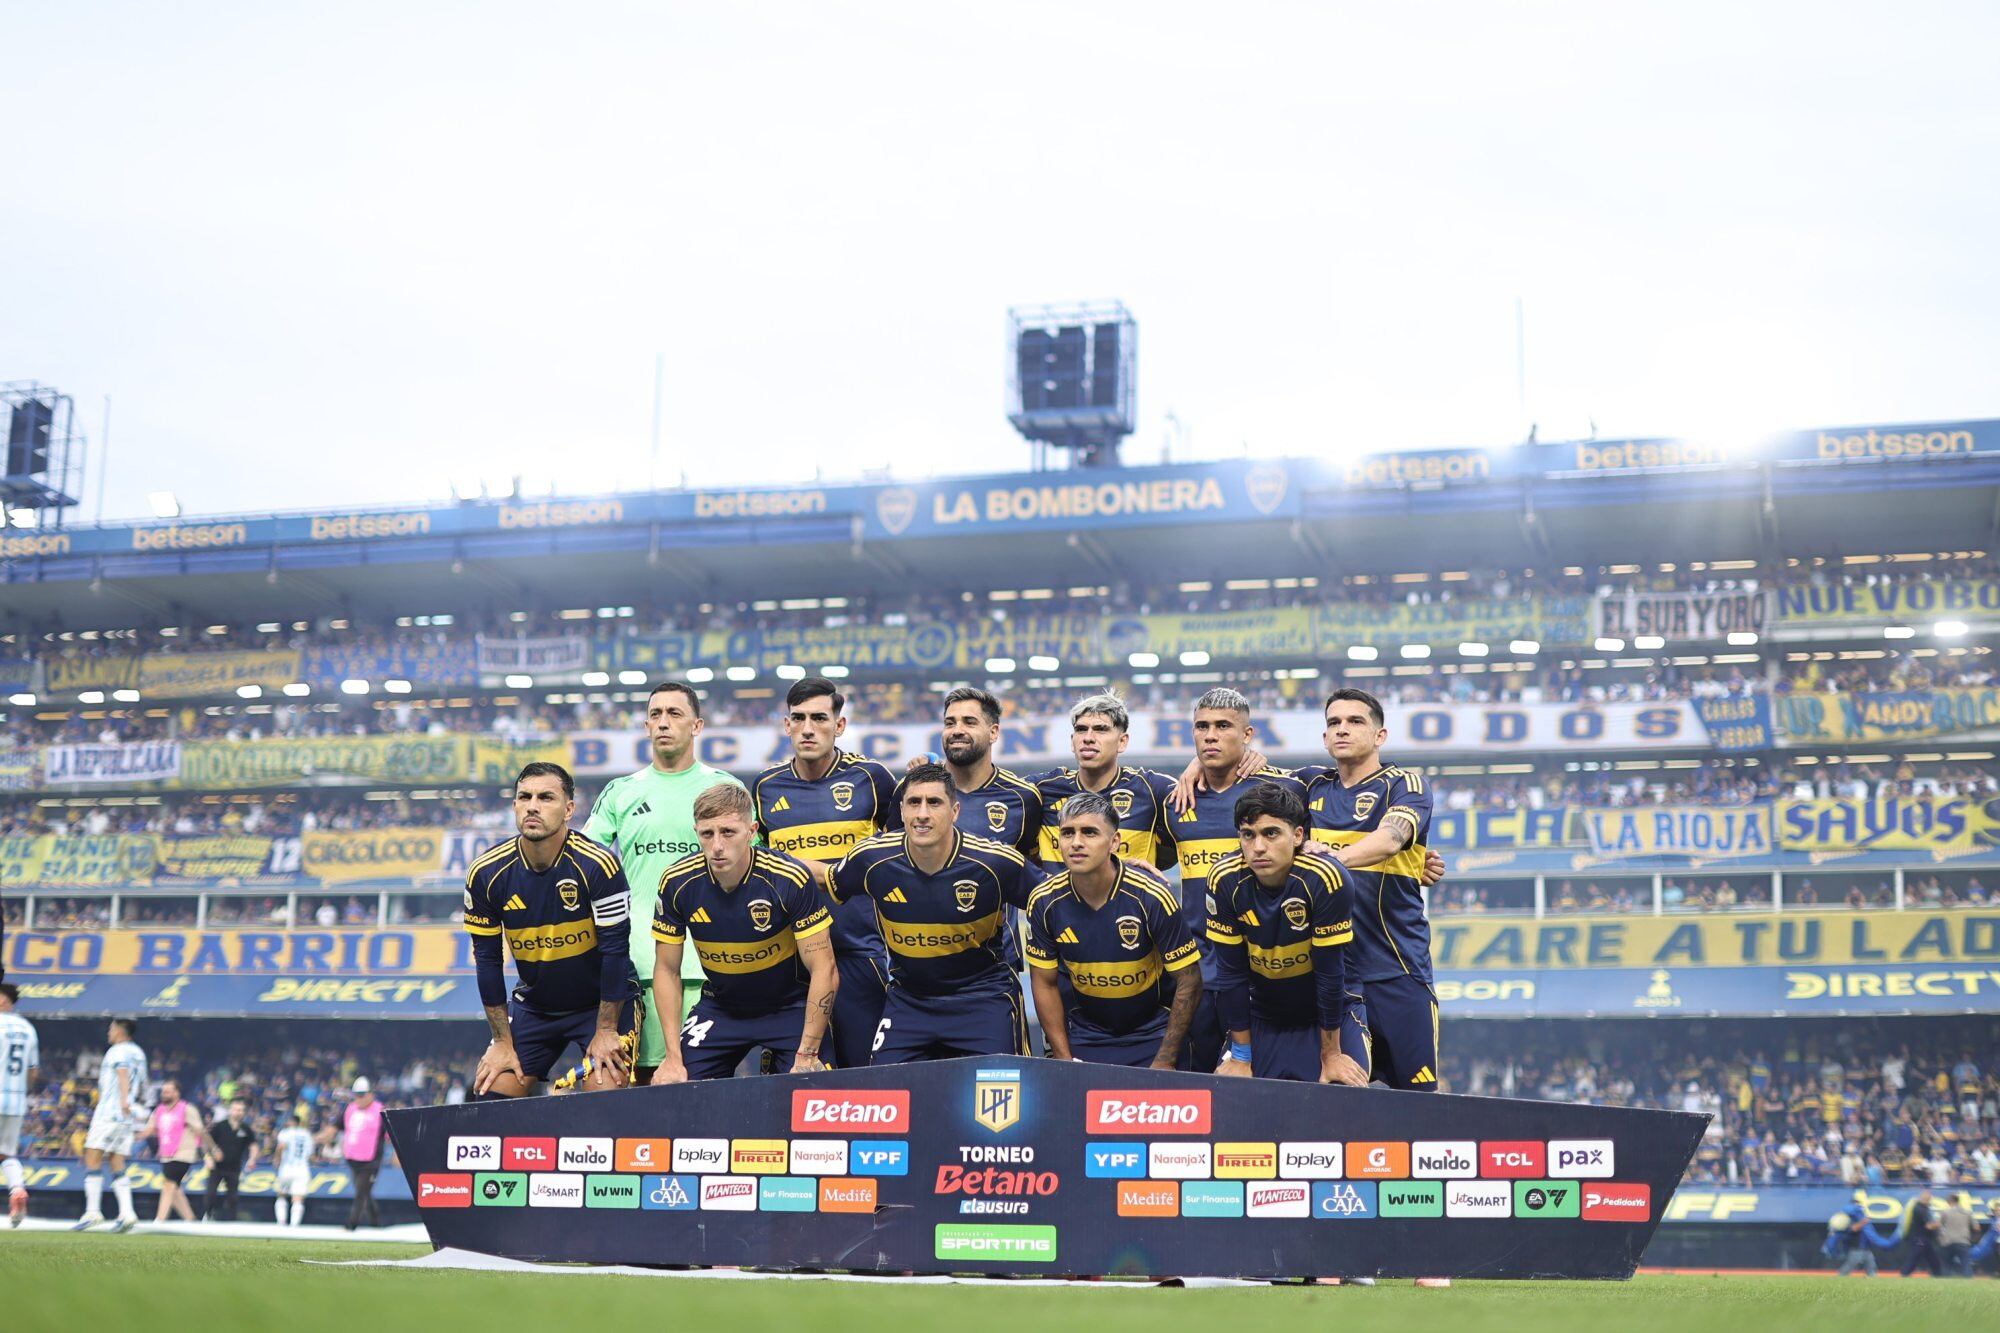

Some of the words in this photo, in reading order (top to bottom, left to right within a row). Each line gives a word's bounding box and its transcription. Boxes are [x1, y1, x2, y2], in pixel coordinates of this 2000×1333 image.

[1818, 429, 1974, 458] betsson
[1577, 441, 1728, 469] betsson
[1343, 452, 1490, 484] betsson
[695, 490, 826, 518] betsson
[934, 492, 979, 524] LA
[986, 478, 1225, 520] BOMBONERA
[498, 499, 623, 529] betsson
[311, 512, 431, 540] betsson
[132, 523, 246, 550] betsson
[1777, 580, 1936, 617] NUEVO
[1409, 708, 1682, 742] ODOS
[1430, 809, 1566, 847] OCA
[1593, 813, 1641, 851] LA
[1654, 810, 1766, 851] RIOJA
[634, 839, 700, 856] betsso
[775, 831, 856, 853] betsson
[1183, 849, 1229, 867] bets
[464, 913, 491, 926] ROGAR
[1315, 919, 1352, 935] CETROGA
[510, 929, 591, 951] betsson
[891, 930, 977, 947] betsson
[1653, 922, 1706, 964] A
[1735, 918, 1821, 962] TU
[1851, 916, 2000, 959] LAD
[5, 932, 104, 972] CO
[133, 931, 415, 974] BARRIO
[697, 942, 781, 964] betsson
[1026, 944, 1047, 957] OGAR
[1251, 953, 1309, 970] etsso
[257, 978, 457, 1003] DIRECTV
[1435, 979, 1537, 1001] son
[680, 1014, 715, 1047] 24
[7, 1044, 25, 1076] 5
[803, 1099, 898, 1123] Betano
[1099, 1100, 1199, 1123] Betano
[456, 1144, 492, 1162] pax
[512, 1147, 547, 1160] TCL
[563, 1145, 608, 1165] Naldo
[678, 1148, 723, 1163] bplay
[734, 1150, 785, 1163] PIRELLI
[858, 1151, 902, 1165] YPF
[959, 1146, 1035, 1163] TORNEO
[1093, 1153, 1139, 1167] YPF
[1217, 1154, 1273, 1167] PIRELLI
[1286, 1153, 1336, 1168] bplay
[1418, 1152, 1471, 1170] Naldo
[1491, 1152, 1533, 1166] TCL
[1558, 1149, 1604, 1169] pax
[660, 1177, 680, 1190] LA
[934, 1165, 1060, 1196] Betano
[610, 1187, 633, 1197] WIN
[650, 1189, 690, 1207] CAJA
[706, 1184, 753, 1199] MANTECOL
[762, 1189, 776, 1199] Sur
[778, 1189, 813, 1199] Finanzas
[824, 1187, 873, 1202] Medifé
[1122, 1192, 1174, 1206] Medifé
[1185, 1195, 1200, 1204] Sur
[1202, 1195, 1240, 1204] Finanzas
[1253, 1189, 1305, 1206] MANTECOL
[1334, 1185, 1357, 1198] LA
[1407, 1194, 1435, 1204] WIN
[962, 1198, 1030, 1214] clausura
[1322, 1197, 1367, 1216] CAJA
[1603, 1197, 1646, 1207] PedidosYa
[1665, 1193, 1759, 1220] FF
